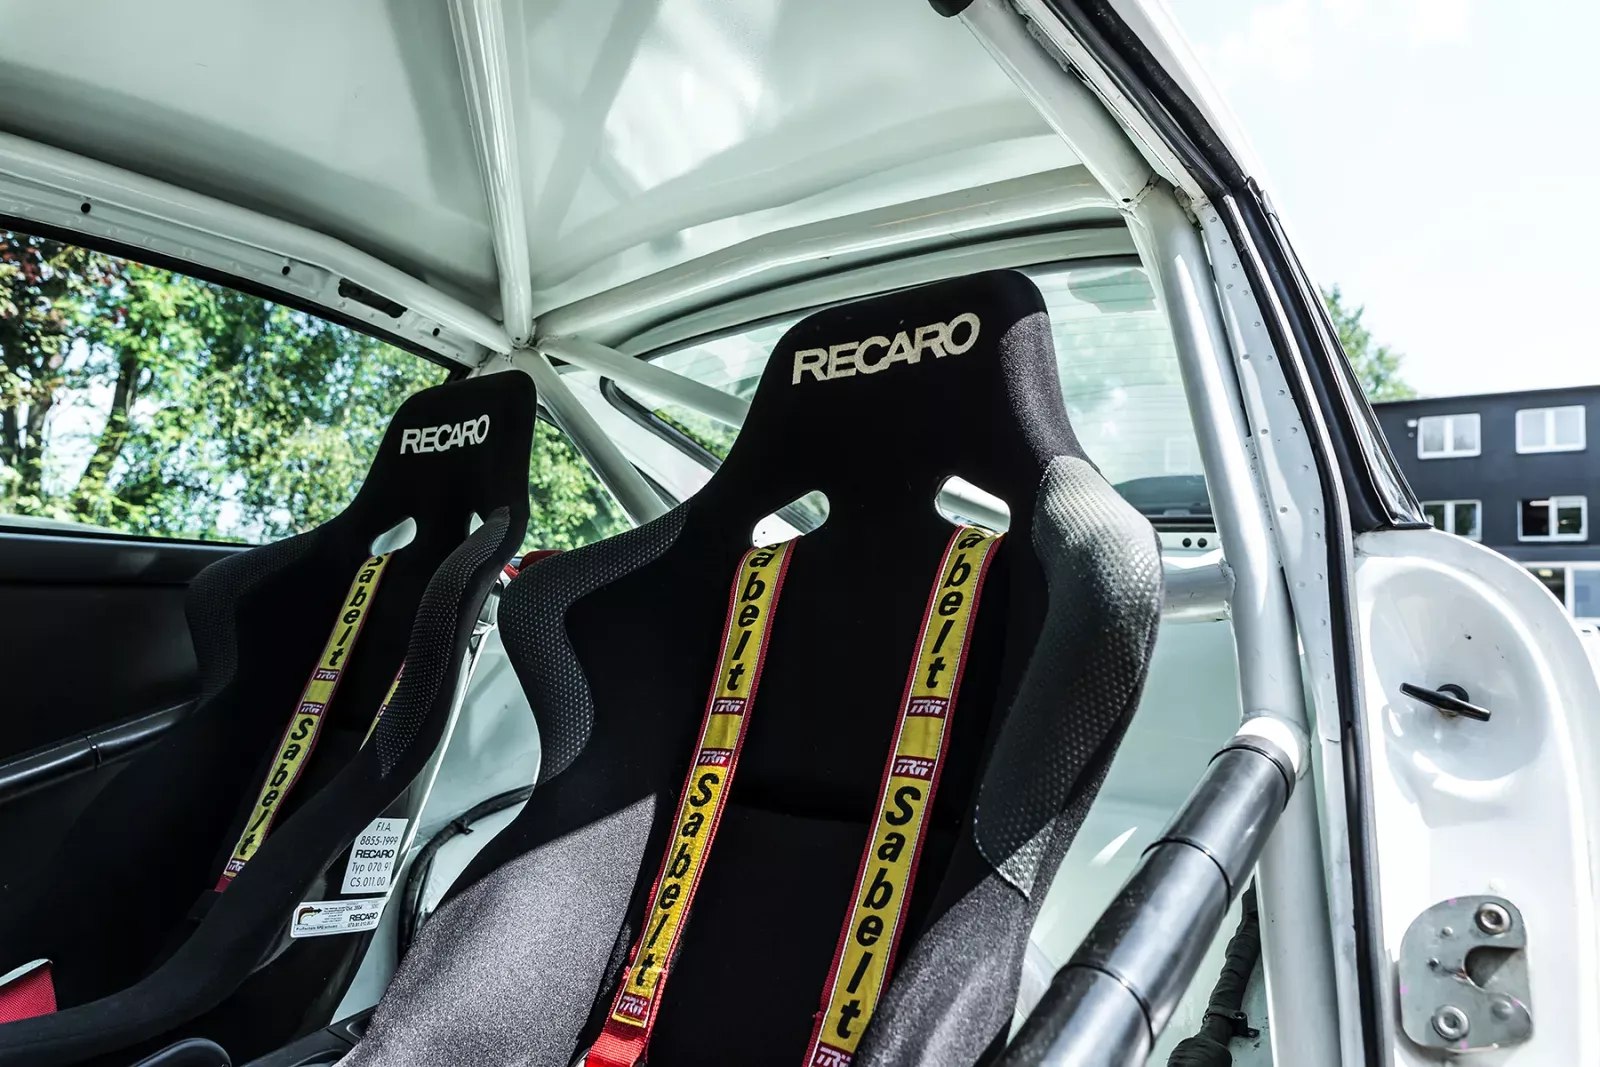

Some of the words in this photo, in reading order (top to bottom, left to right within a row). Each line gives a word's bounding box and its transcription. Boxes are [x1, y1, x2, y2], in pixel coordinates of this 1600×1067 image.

[792, 312, 980, 385] RECARO
[400, 414, 490, 455] RECARO
[727, 543, 781, 691] abelt
[925, 529, 986, 689] abelt
[910, 699, 947, 715] TRW
[239, 717, 314, 856] Sabelt
[895, 758, 935, 777] TRW
[355, 849, 395, 859] RECARO
[360, 835, 399, 846] 8855-1999
[351, 861, 366, 875] Typ
[635, 772, 720, 987] Sabelt
[348, 911, 379, 922] RECARO
[836, 785, 922, 1039] Sabelt
